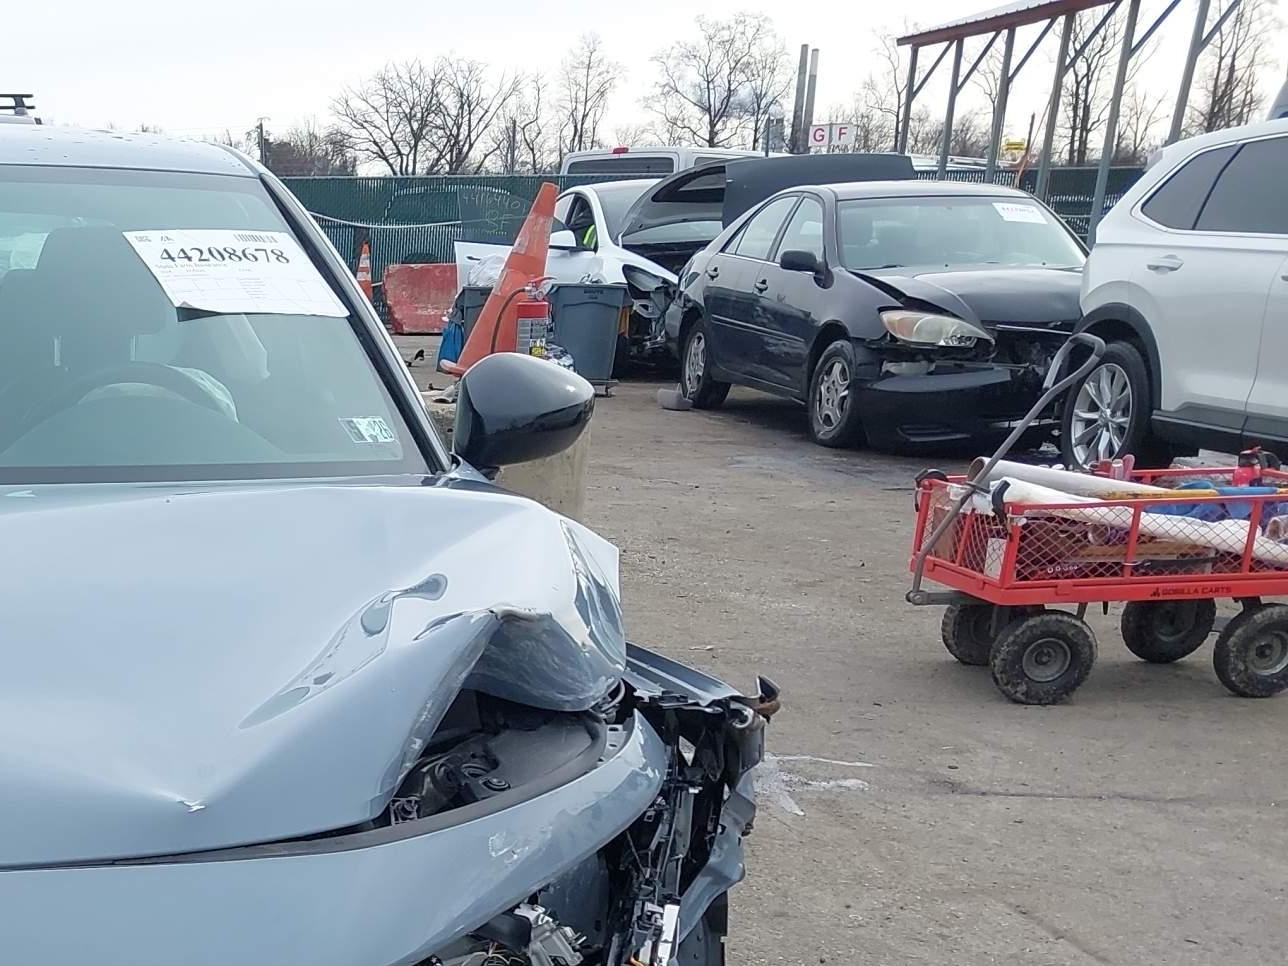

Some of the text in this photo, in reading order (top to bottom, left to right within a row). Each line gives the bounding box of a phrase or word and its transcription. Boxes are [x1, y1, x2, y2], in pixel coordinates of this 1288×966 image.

[813, 127, 825, 142] G
[838, 126, 848, 141] F
[160, 246, 290, 264] 44208678
[1201, 586, 1232, 594] CARTS
